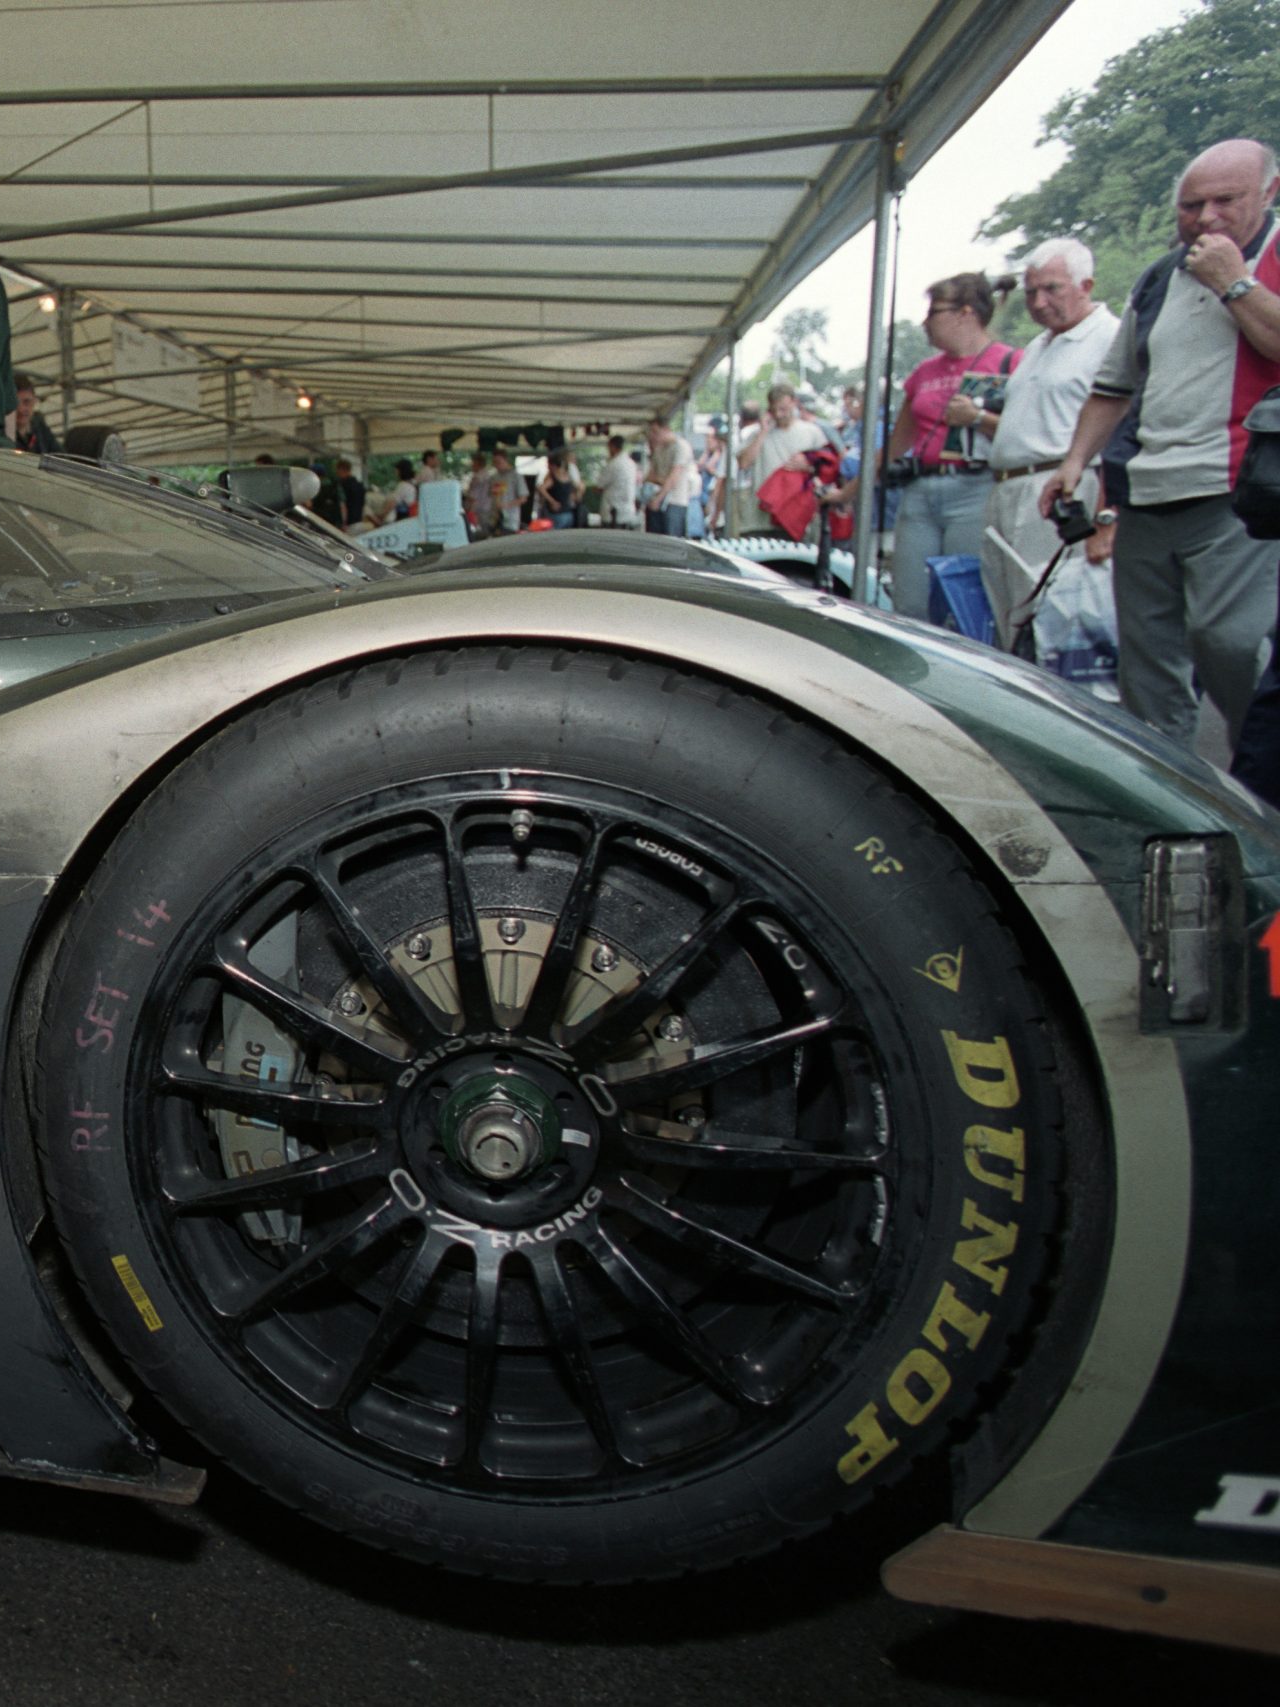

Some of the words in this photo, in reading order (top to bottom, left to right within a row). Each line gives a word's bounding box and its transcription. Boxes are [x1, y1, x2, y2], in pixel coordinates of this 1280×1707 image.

[76, 968, 129, 1052] SET
[116, 899, 171, 946] 14
[489, 1186, 603, 1248] RACING
[836, 1029, 1025, 1485] DUNLOP
